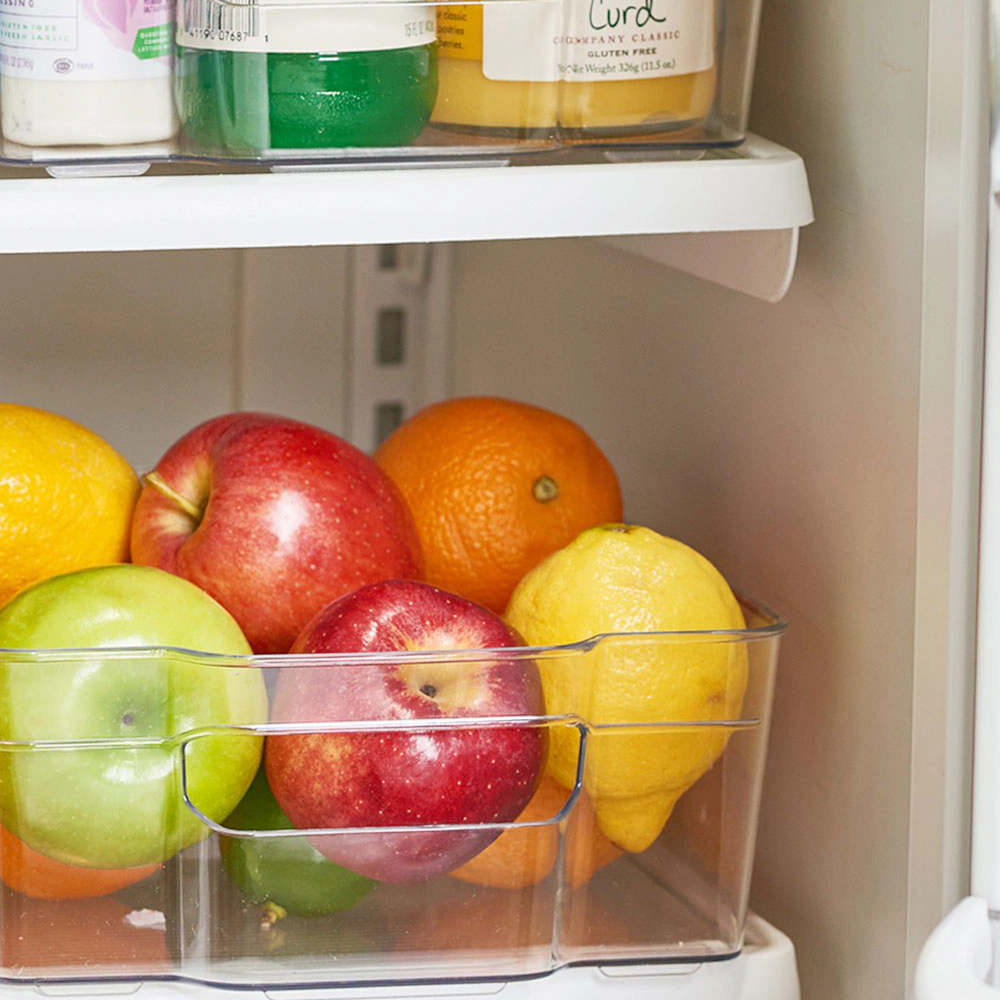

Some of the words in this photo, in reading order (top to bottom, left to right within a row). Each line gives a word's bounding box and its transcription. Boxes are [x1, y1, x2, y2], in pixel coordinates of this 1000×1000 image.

[443, 10, 467, 21] classic
[632, 30, 680, 42] CLASSIC
[587, 50, 629, 58] GLUTEN
[632, 47, 658, 56] FREE
[585, 63, 616, 76] Weight
[619, 62, 640, 74] 326g
[641, 60, 661, 72] (11.5
